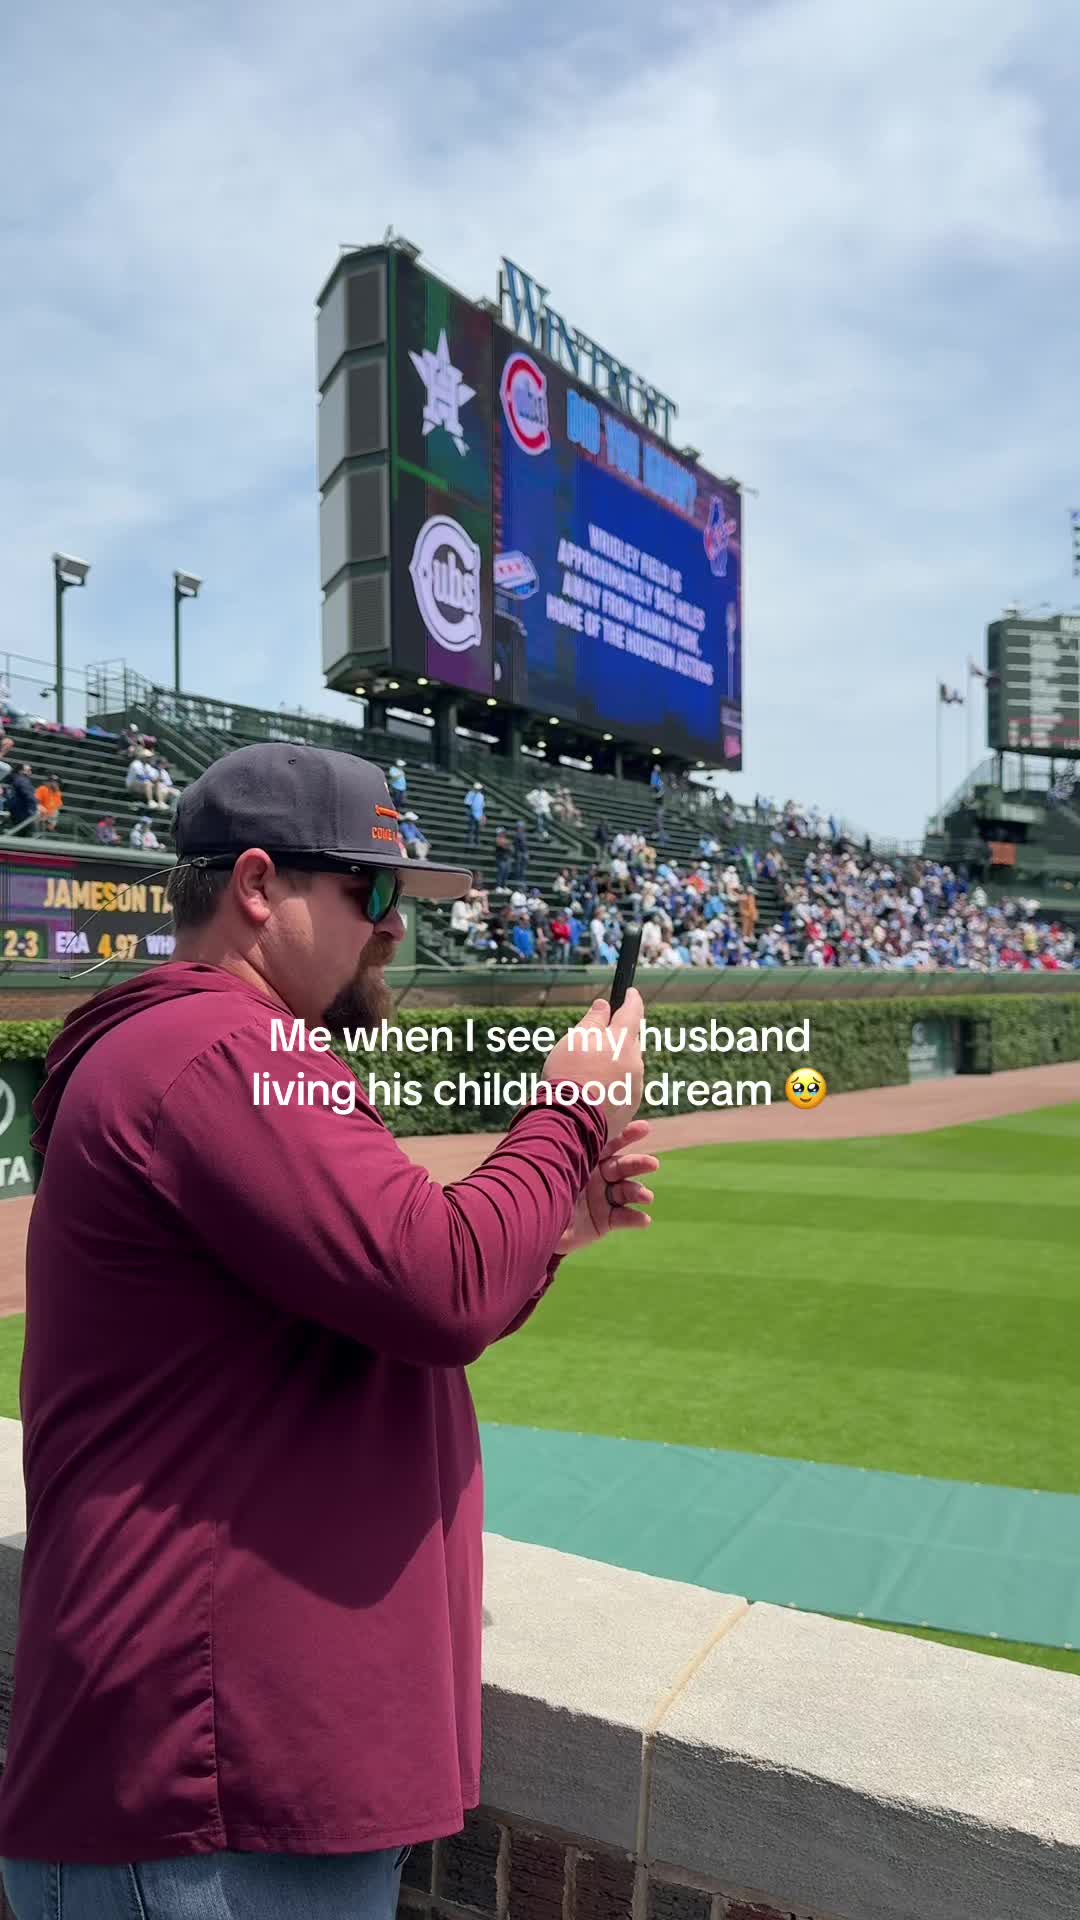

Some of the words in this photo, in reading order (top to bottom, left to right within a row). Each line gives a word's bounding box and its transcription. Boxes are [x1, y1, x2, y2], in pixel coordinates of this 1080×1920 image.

[498, 256, 678, 441] WINTRUST
[43, 877, 147, 913] JAMESON
[55, 931, 91, 954] ERA
